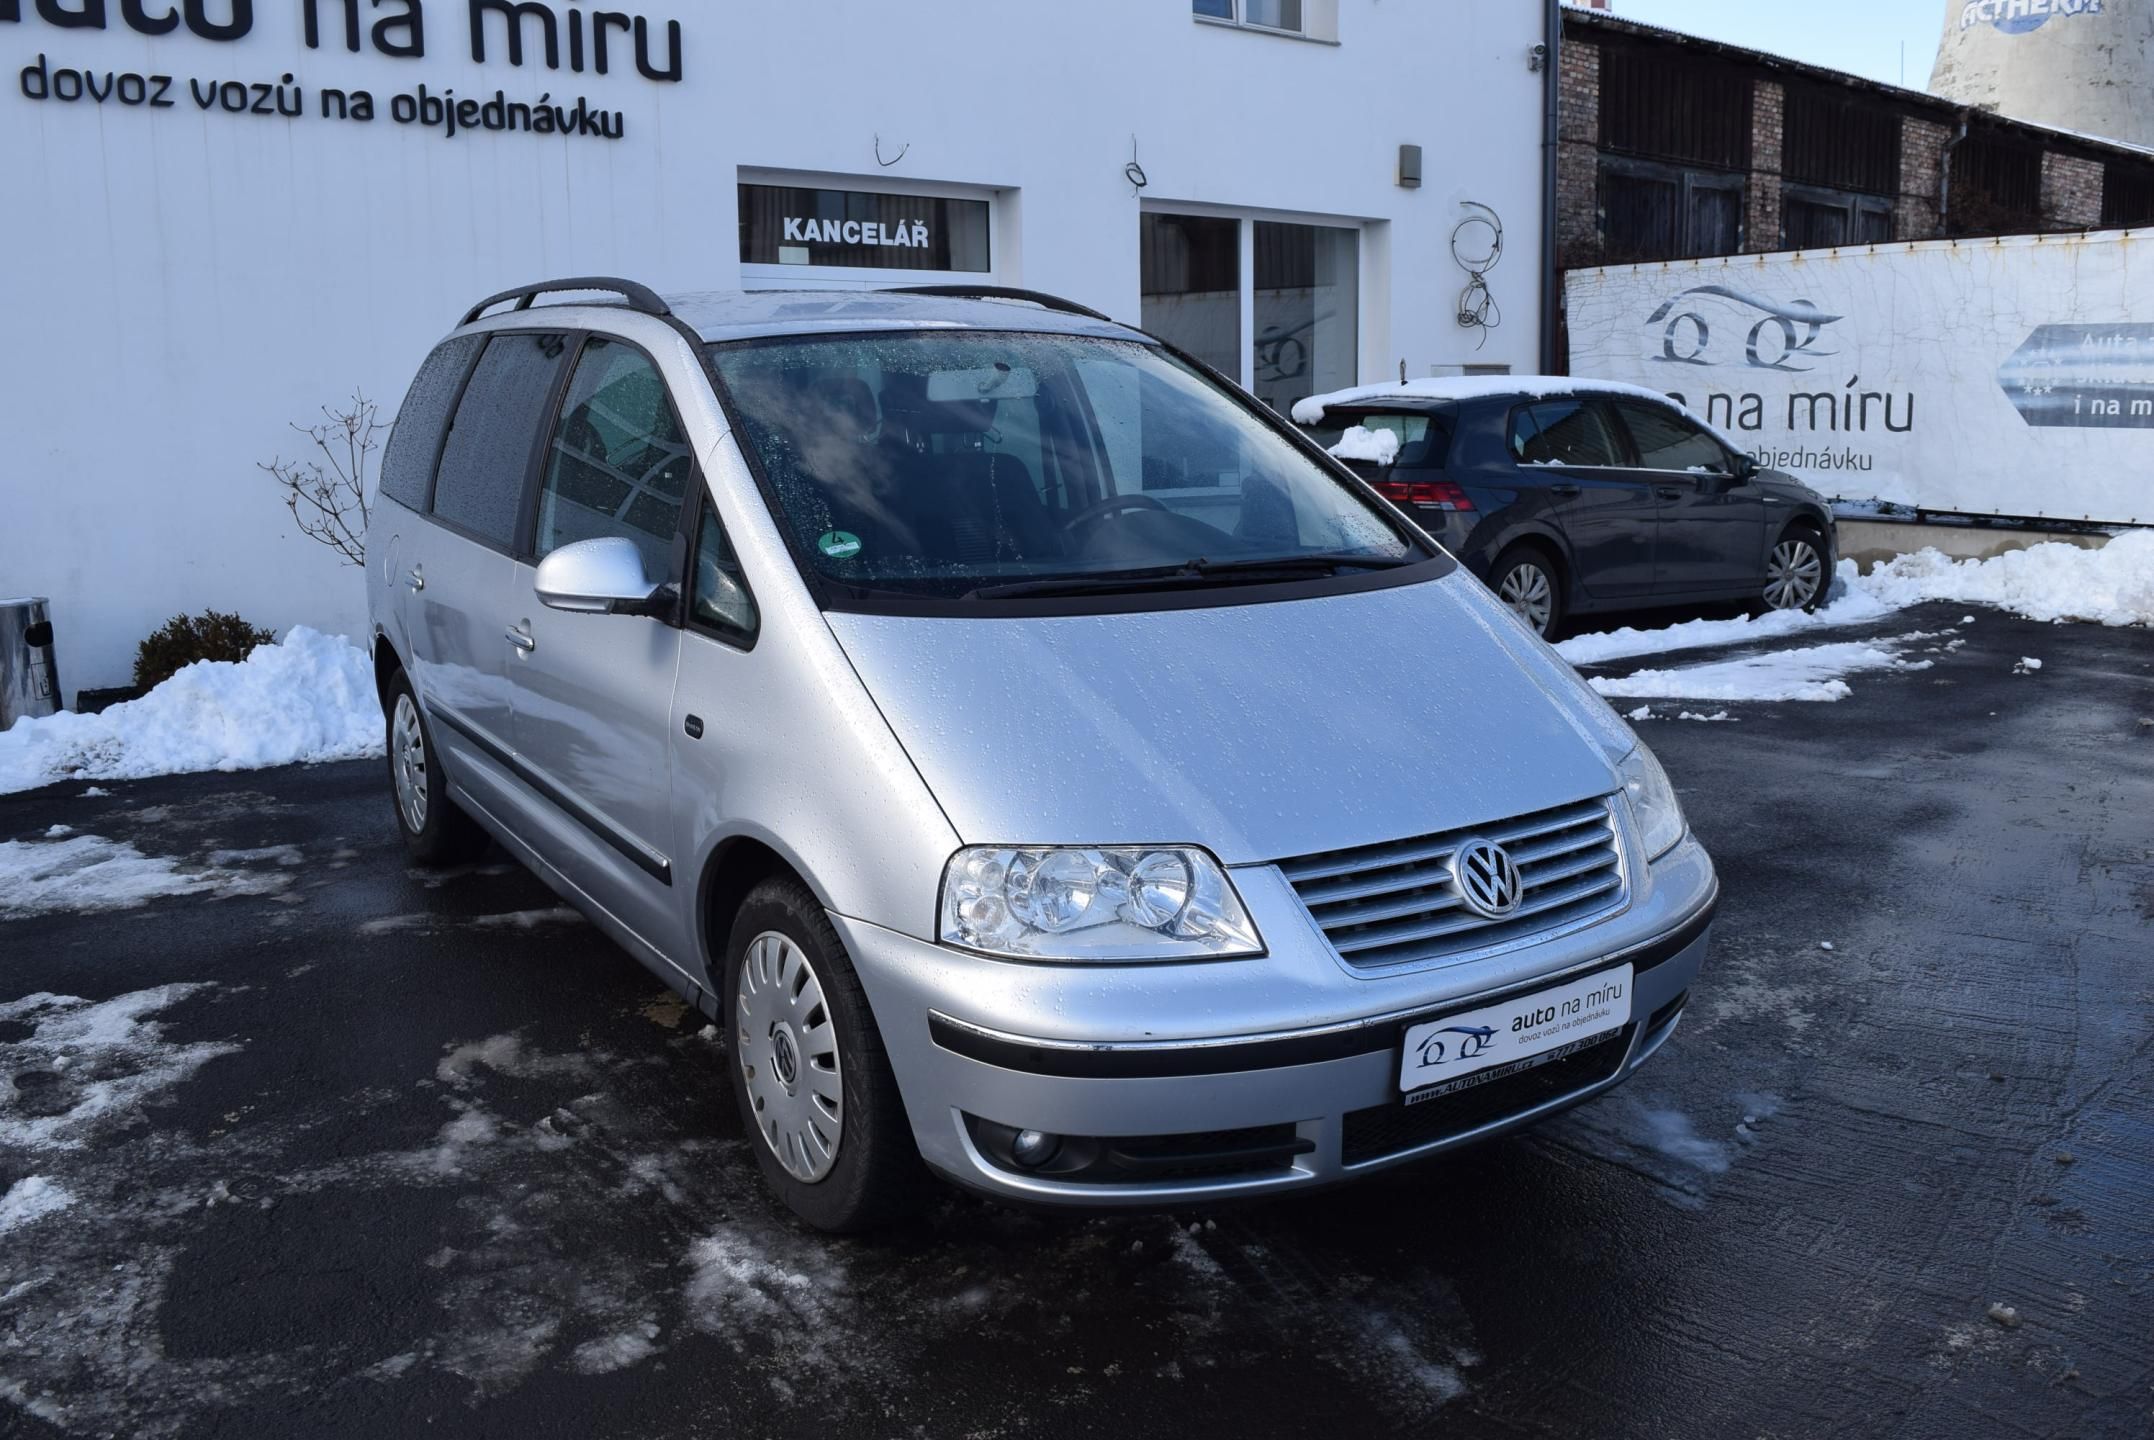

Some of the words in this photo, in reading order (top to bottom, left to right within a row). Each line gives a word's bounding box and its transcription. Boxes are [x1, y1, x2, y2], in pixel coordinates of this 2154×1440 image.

[302, 0, 425, 58] na
[20, 53, 175, 107] dovoz
[190, 73, 302, 116] vozů
[321, 89, 375, 120] na
[391, 83, 624, 138] objednávku
[783, 216, 929, 248] KANCELÁŘ
[1707, 392, 1763, 431] na
[1788, 374, 1914, 432] míru
[2074, 394, 2082, 415] i
[2091, 399, 2121, 415] na
[1511, 1006, 1555, 1032] auto
[1561, 998, 1580, 1017] na
[1586, 982, 1622, 1009] míru
[1518, 1031, 1541, 1044] dovoz
[1561, 1021, 1571, 1031] na
